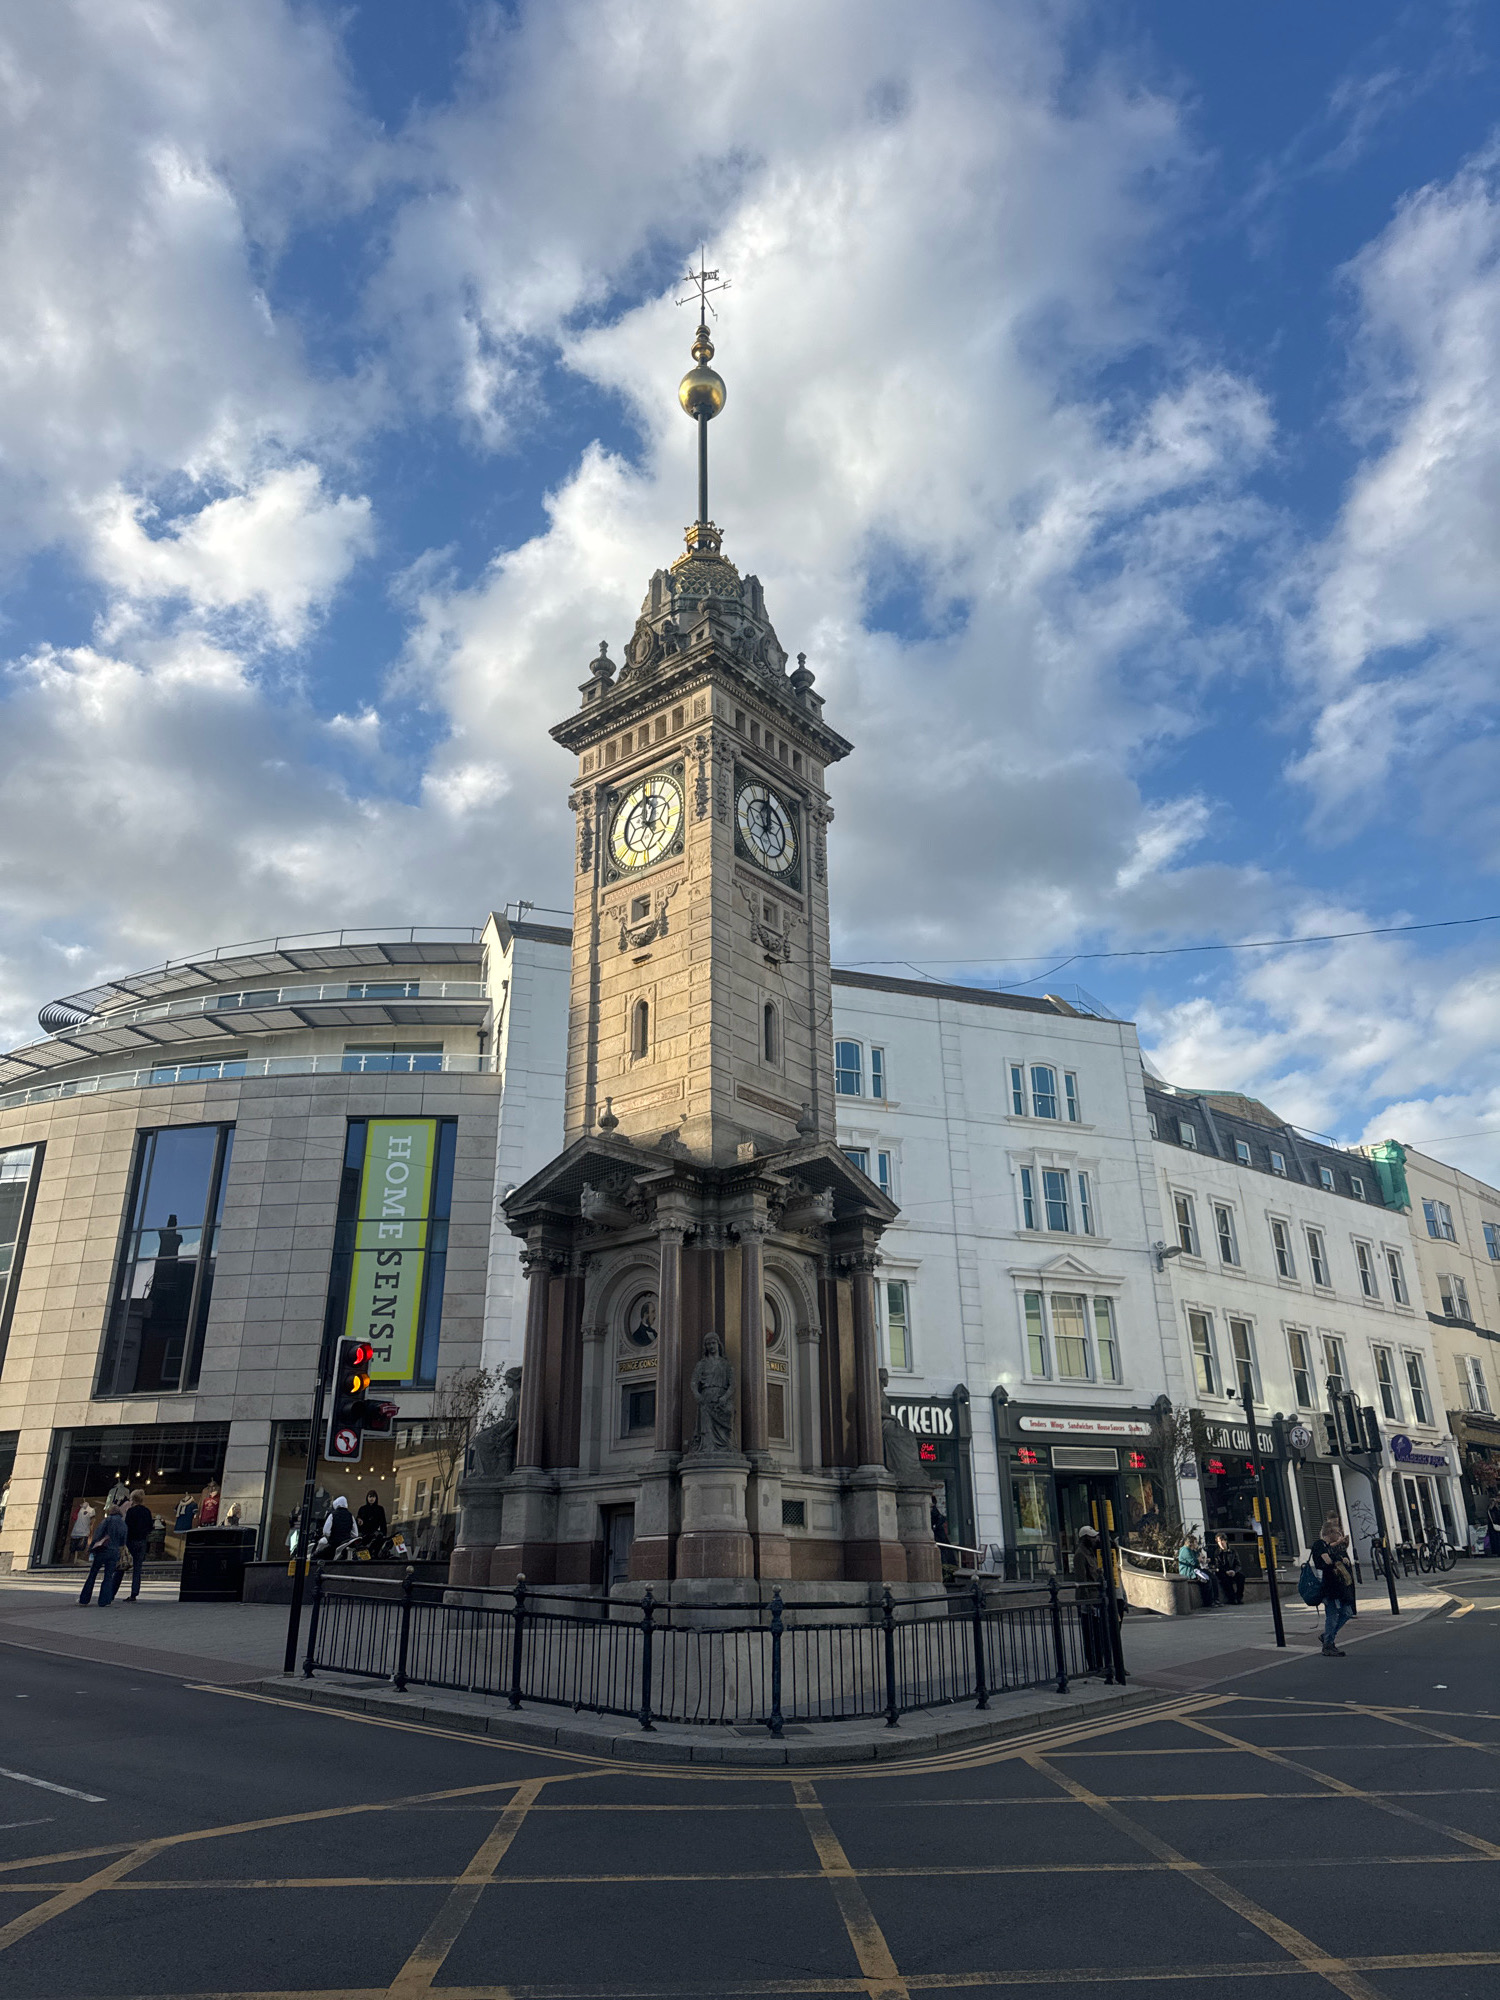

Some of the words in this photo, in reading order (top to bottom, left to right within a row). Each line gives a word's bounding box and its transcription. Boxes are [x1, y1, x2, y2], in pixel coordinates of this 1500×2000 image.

[639, 1358, 658, 1369] CONSO
[890, 1405, 954, 1436] CKENS
[1050, 1420, 1065, 1429] Wings
[1067, 1421, 1094, 1431] Sandwiches
[1206, 1426, 1231, 1449] SLM
[1231, 1429, 1274, 1454] CHICENS
